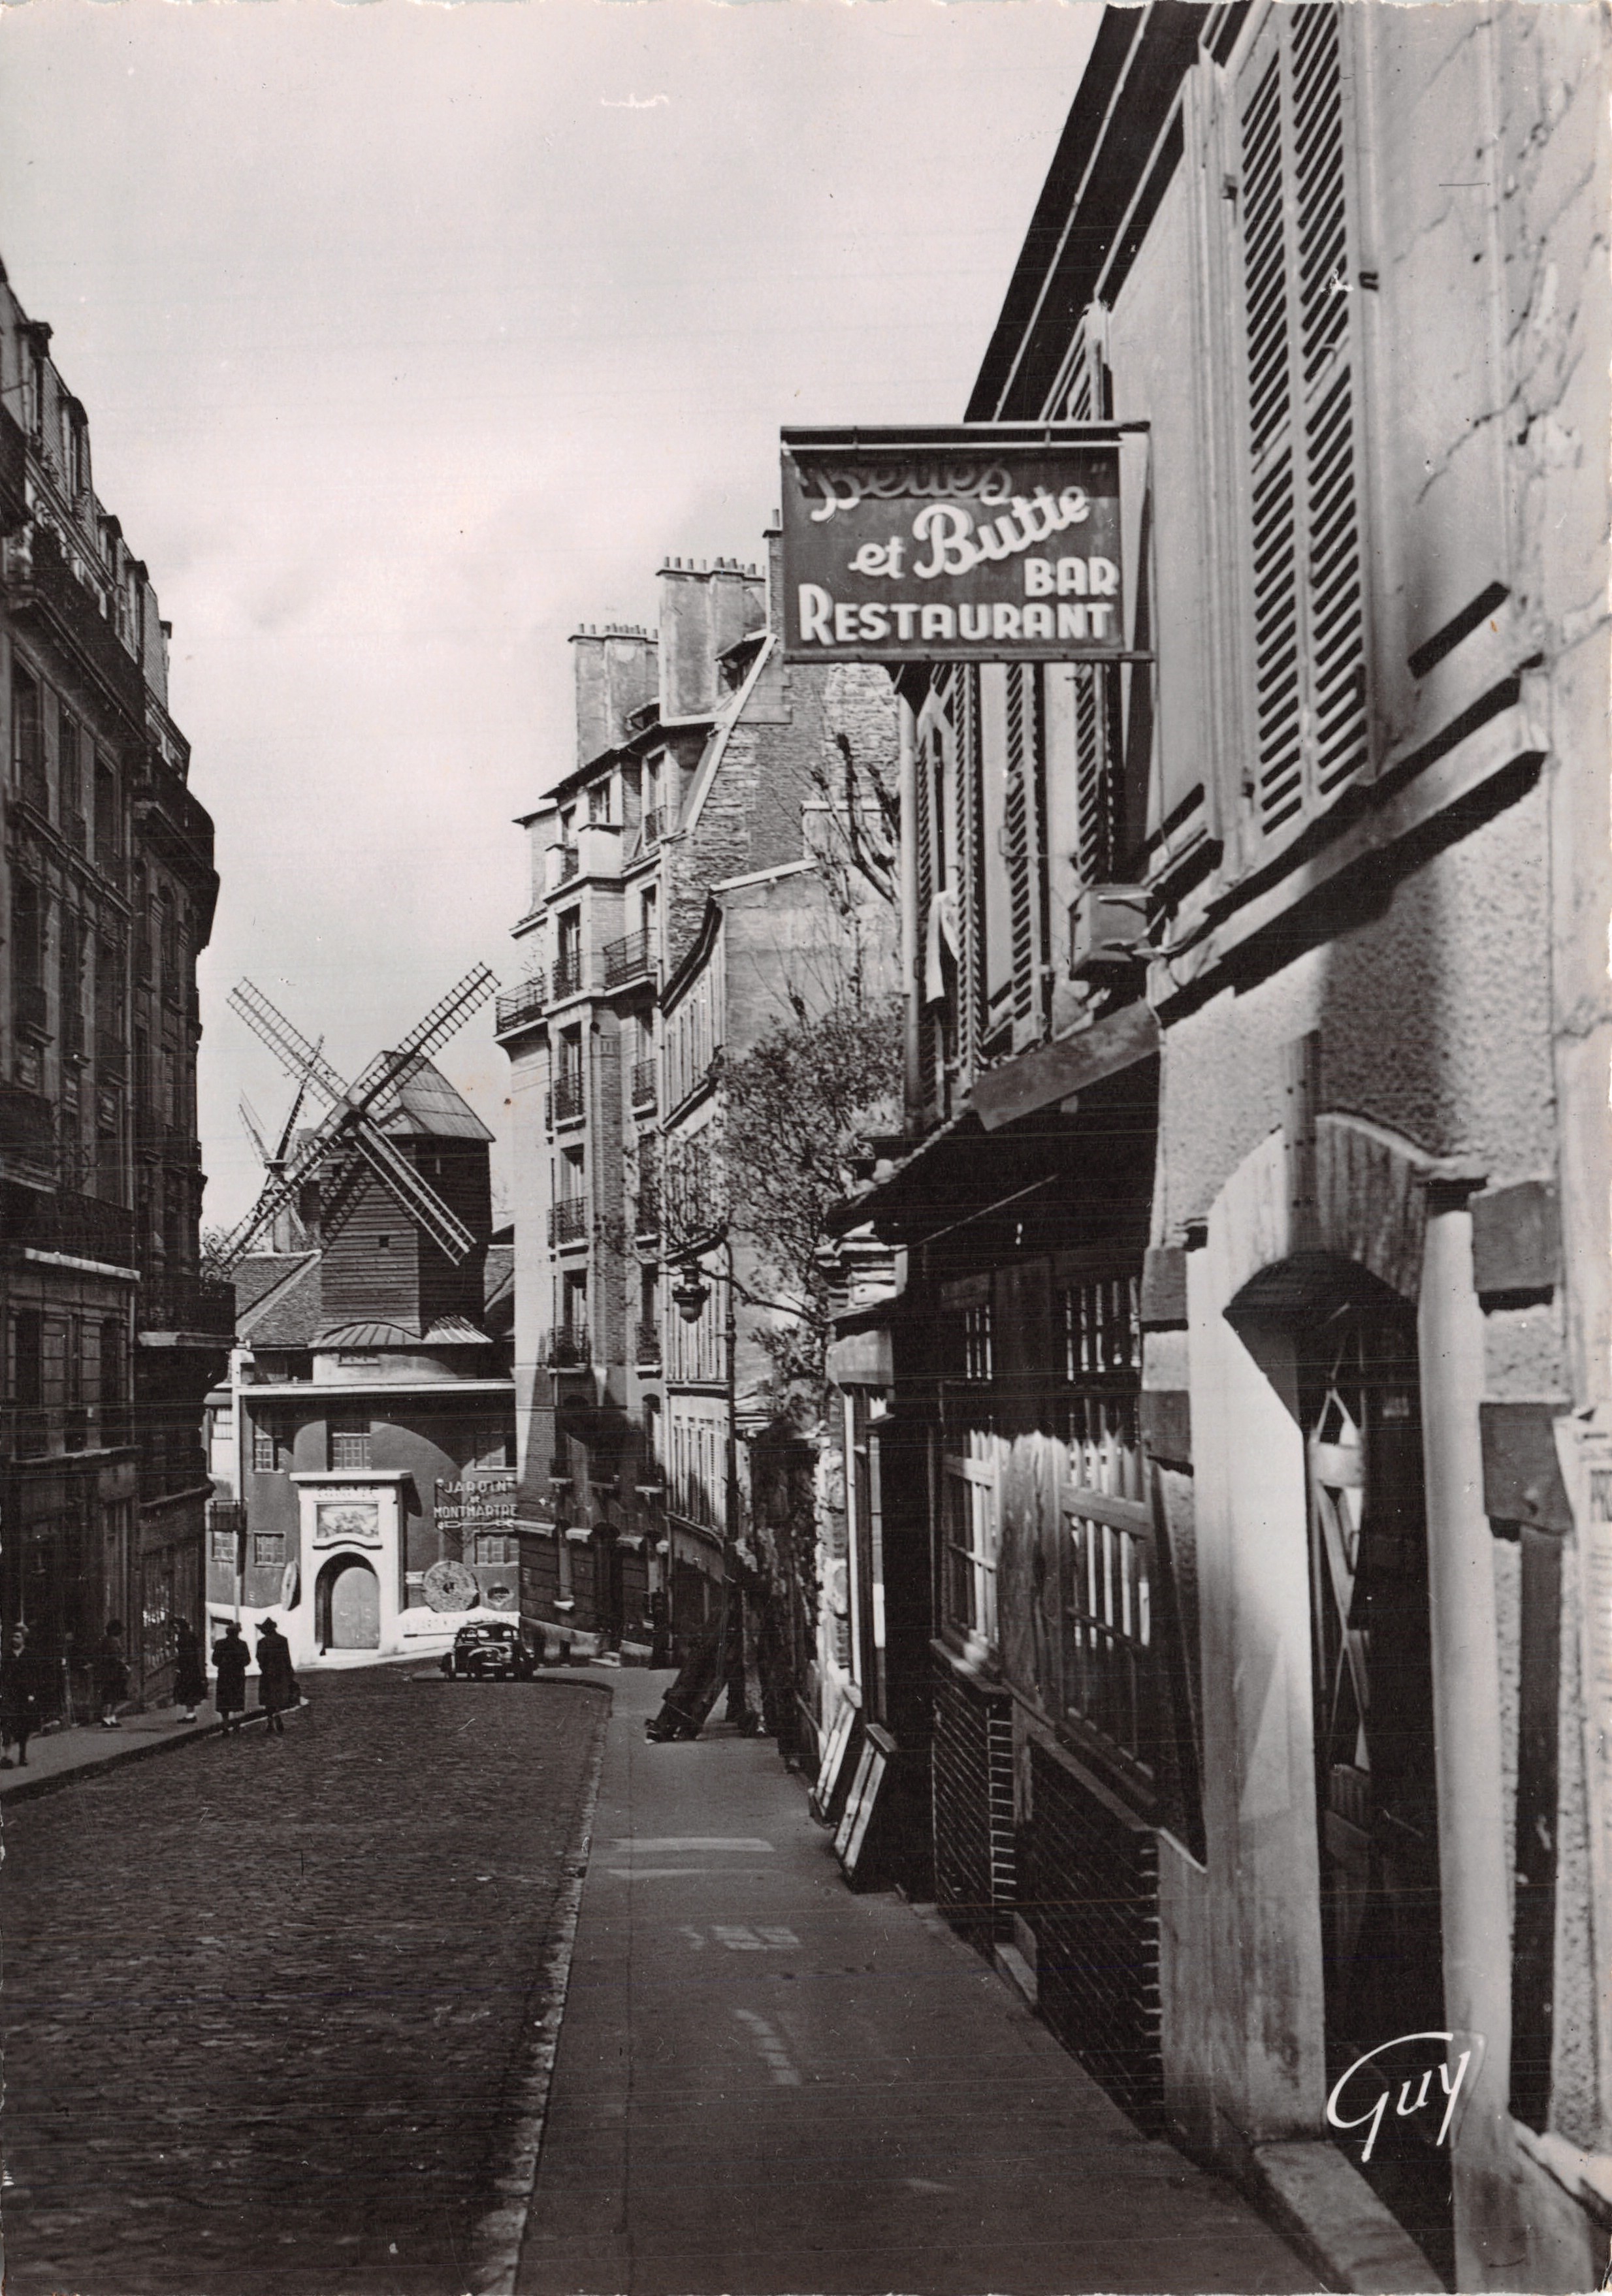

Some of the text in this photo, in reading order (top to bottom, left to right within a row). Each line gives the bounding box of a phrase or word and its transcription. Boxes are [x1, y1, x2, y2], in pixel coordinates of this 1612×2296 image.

[848, 485, 1090, 579] et Butte
[1024, 556, 1120, 598] BAR
[798, 583, 1114, 646] RESTAURANT
[445, 1480, 508, 1494] JARDIN
[433, 1504, 519, 1518] MONTMARTRE
